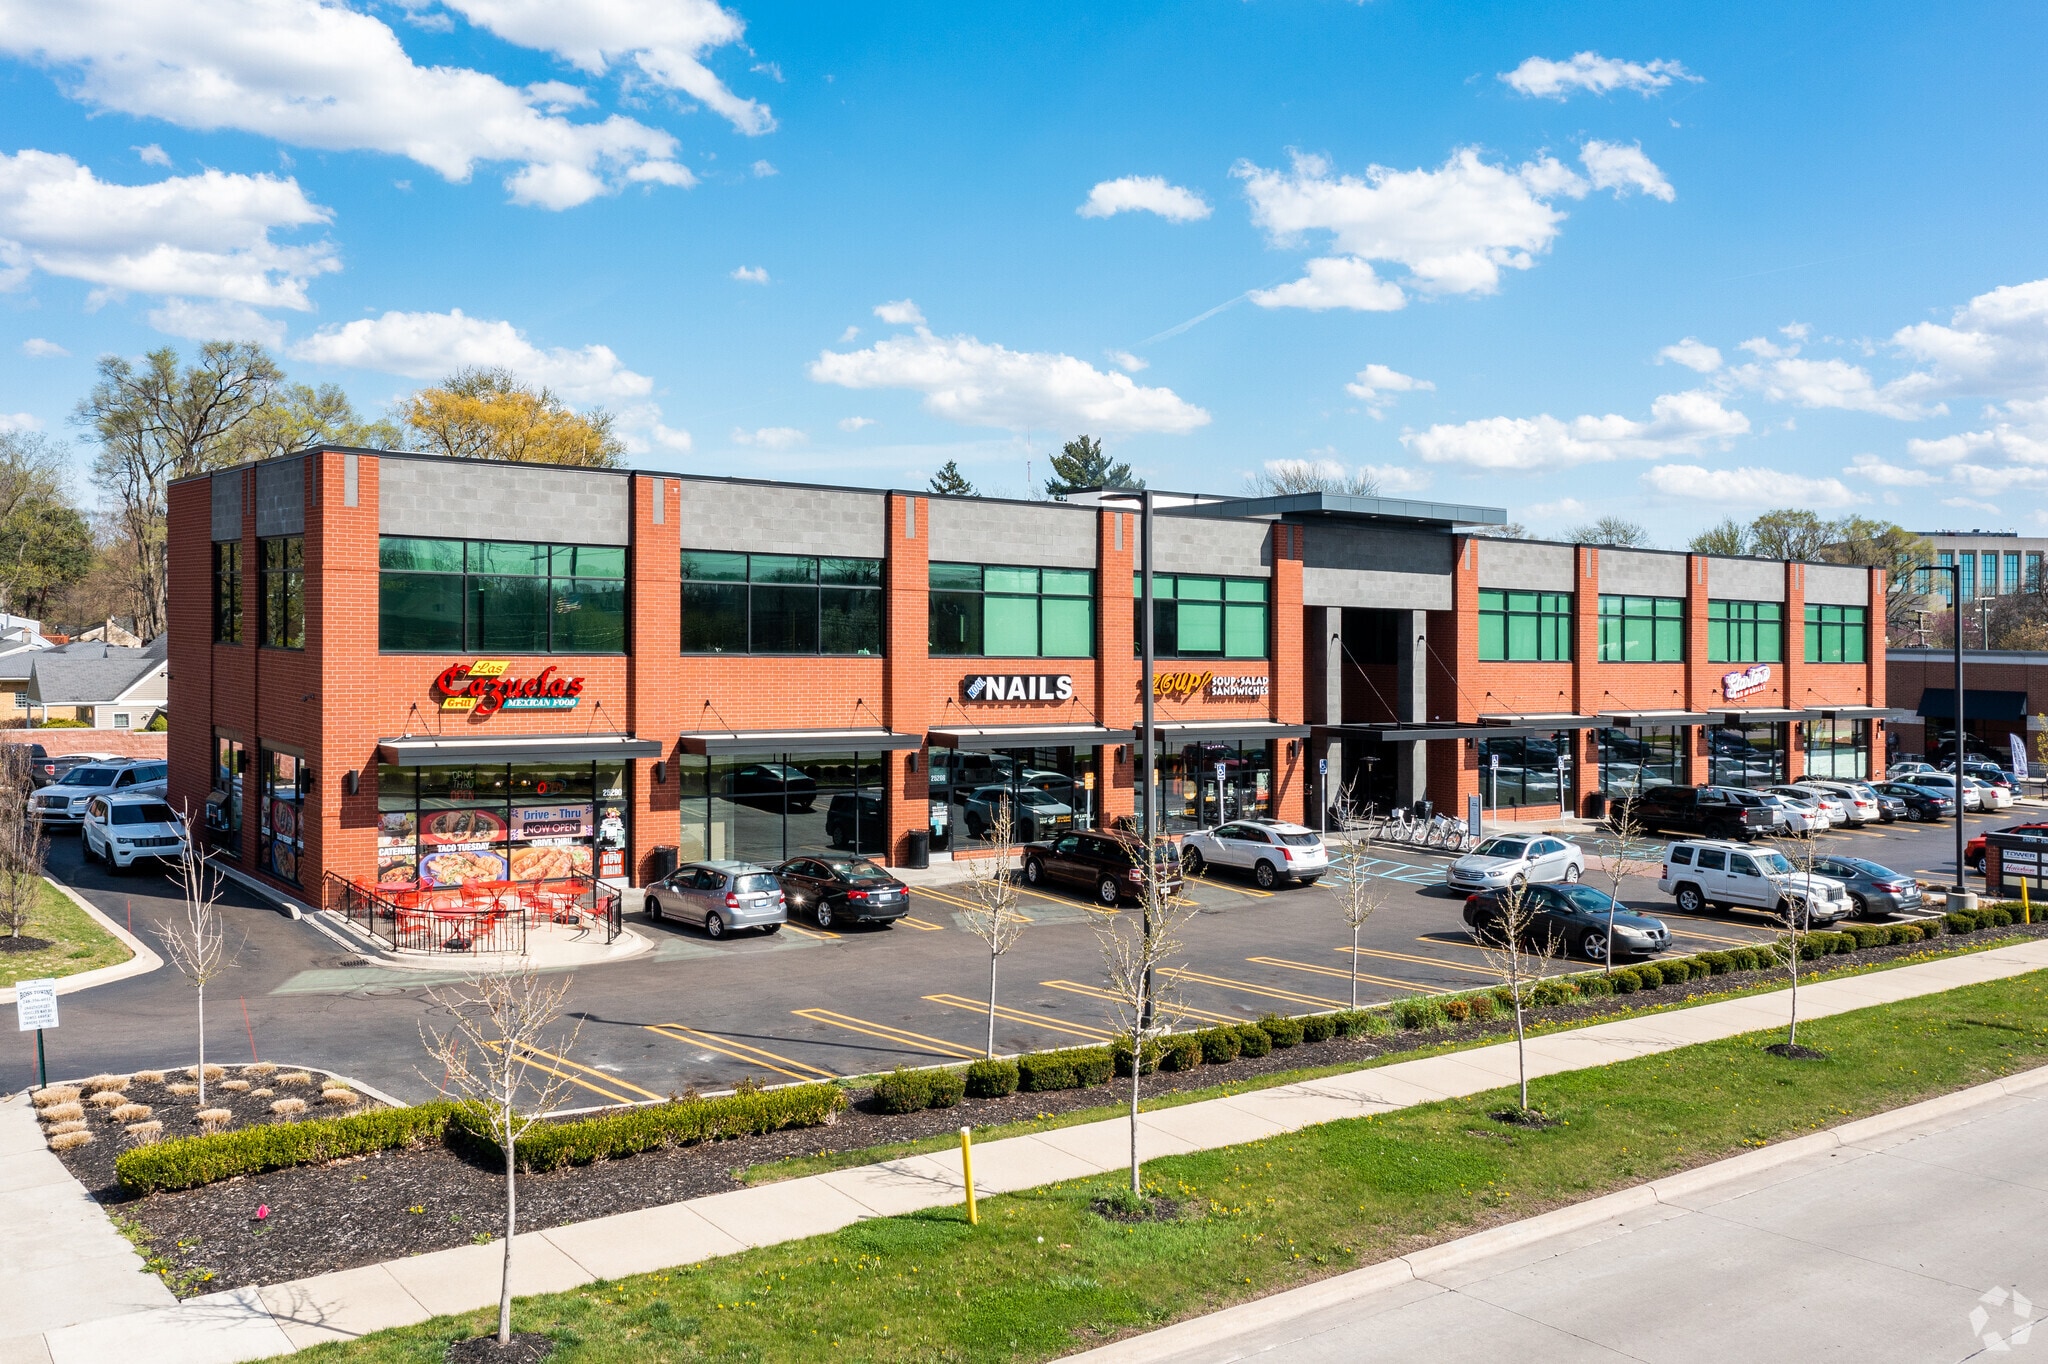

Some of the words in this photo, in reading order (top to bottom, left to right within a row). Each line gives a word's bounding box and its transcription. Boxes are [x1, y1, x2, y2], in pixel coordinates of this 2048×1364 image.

[472, 662, 502, 674] Las
[437, 663, 585, 716] Cazuelas
[967, 676, 987, 700] KOOL
[985, 675, 1073, 700] NAILS
[1211, 686, 1269, 696] SANDWICHES
[447, 699, 471, 707] Grill
[507, 699, 551, 707] MEXICAN
[552, 698, 576, 706] FOOD
[524, 810, 549, 820] Drive
[559, 808, 581, 818] Thru
[524, 824, 550, 834] NOW
[552, 822, 577, 832] OPEN
[437, 844, 457, 853] TACO
[458, 842, 490, 852] TUESDAY
[532, 838, 553, 847] DRIVE
[378, 846, 416, 856] CATERING
